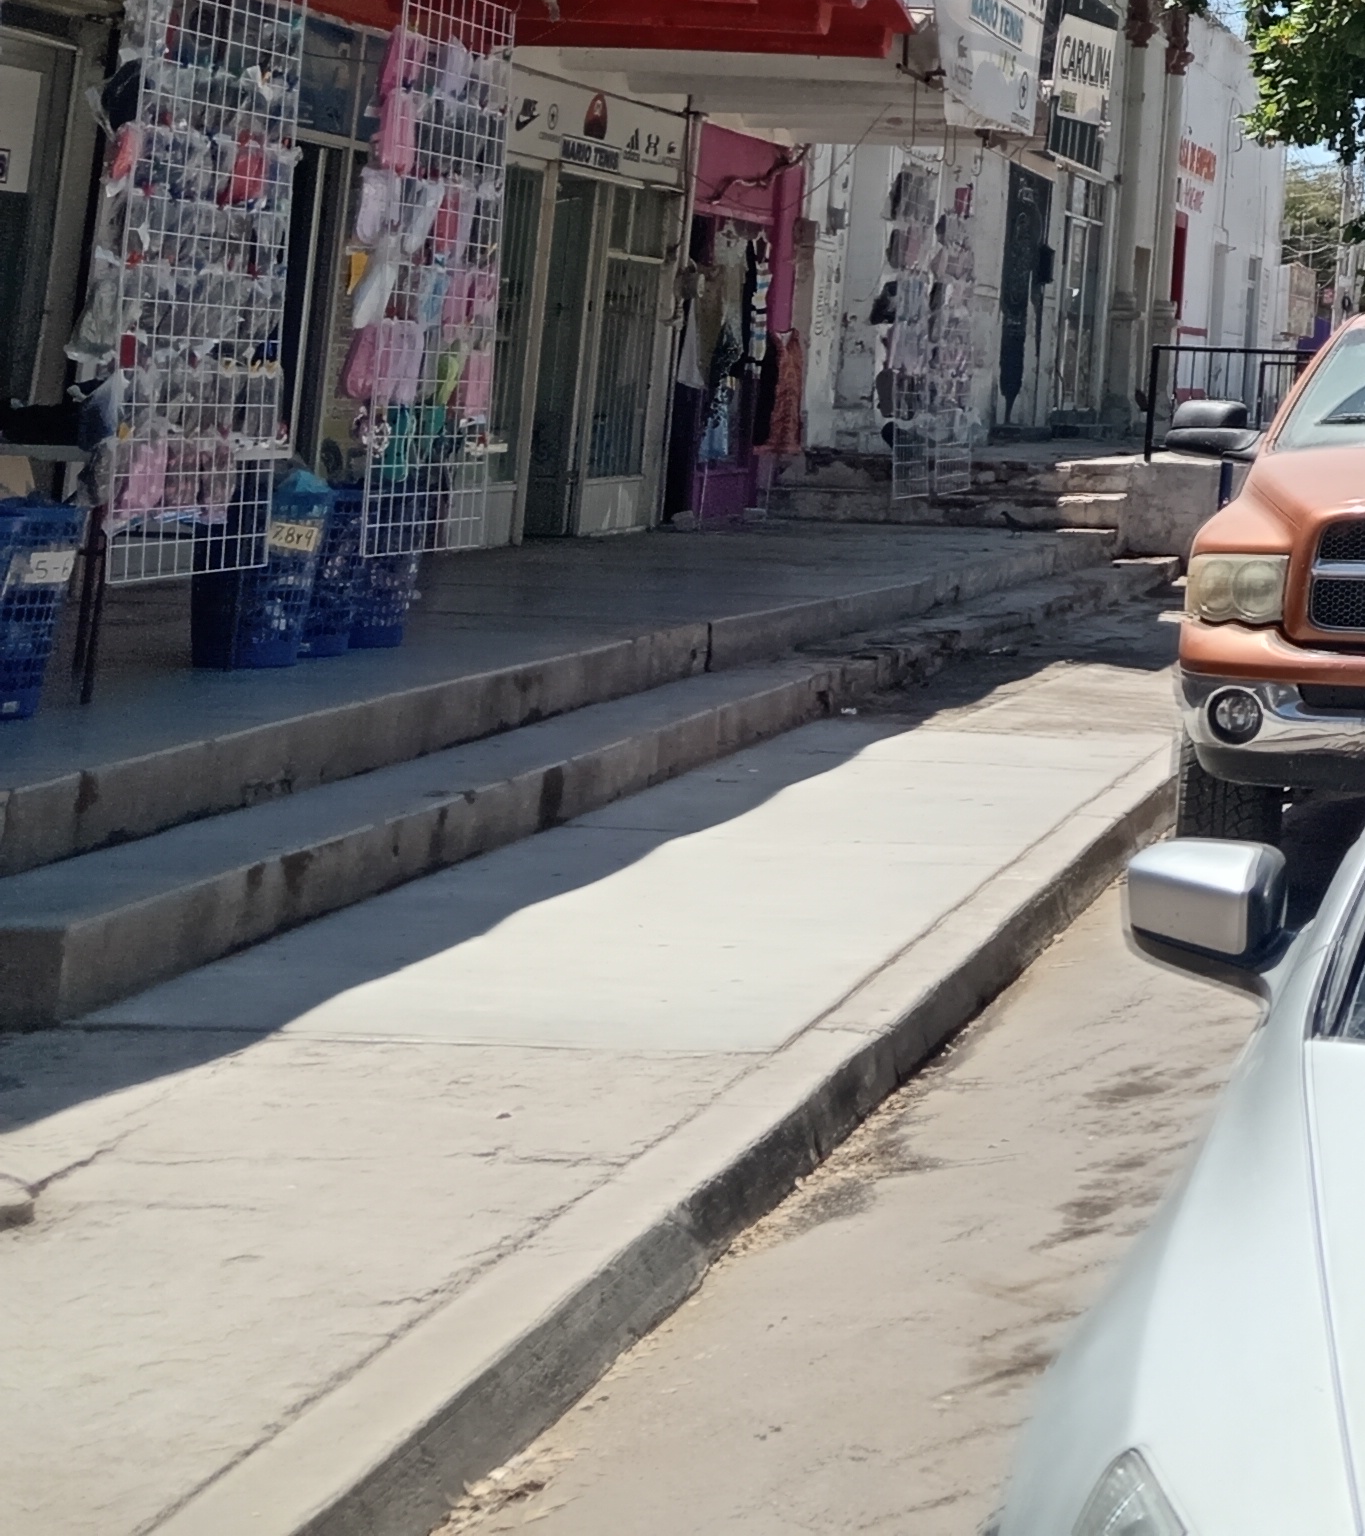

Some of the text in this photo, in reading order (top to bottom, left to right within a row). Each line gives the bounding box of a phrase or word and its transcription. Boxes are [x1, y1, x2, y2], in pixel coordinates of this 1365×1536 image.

[1000, 6, 1024, 45] TENIS
[1060, 35, 1112, 88] CAROLINA
[562, 139, 591, 163] MARIO
